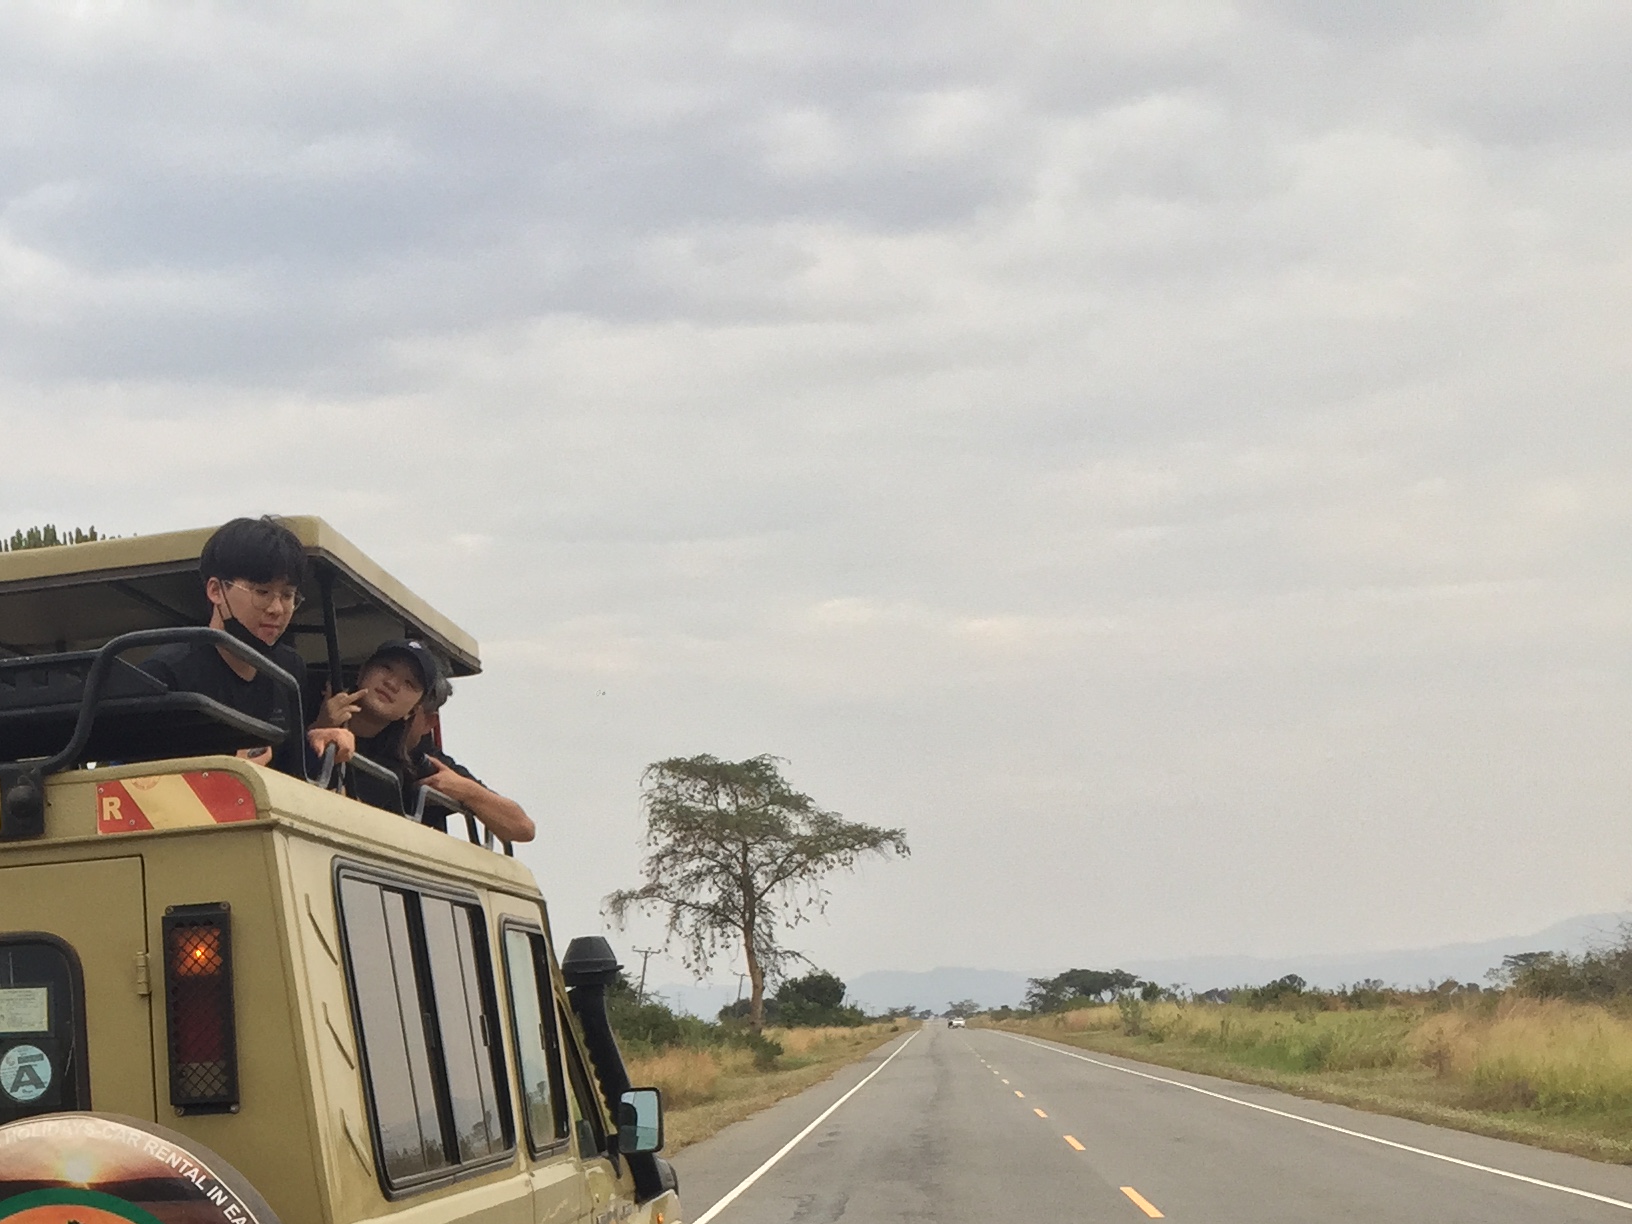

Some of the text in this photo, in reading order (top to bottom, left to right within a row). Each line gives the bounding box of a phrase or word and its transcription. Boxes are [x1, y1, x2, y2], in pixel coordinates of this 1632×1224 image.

[102, 796, 123, 821] R
[144, 1139, 209, 1190] RENTAL
[206, 1184, 228, 1207] IN
